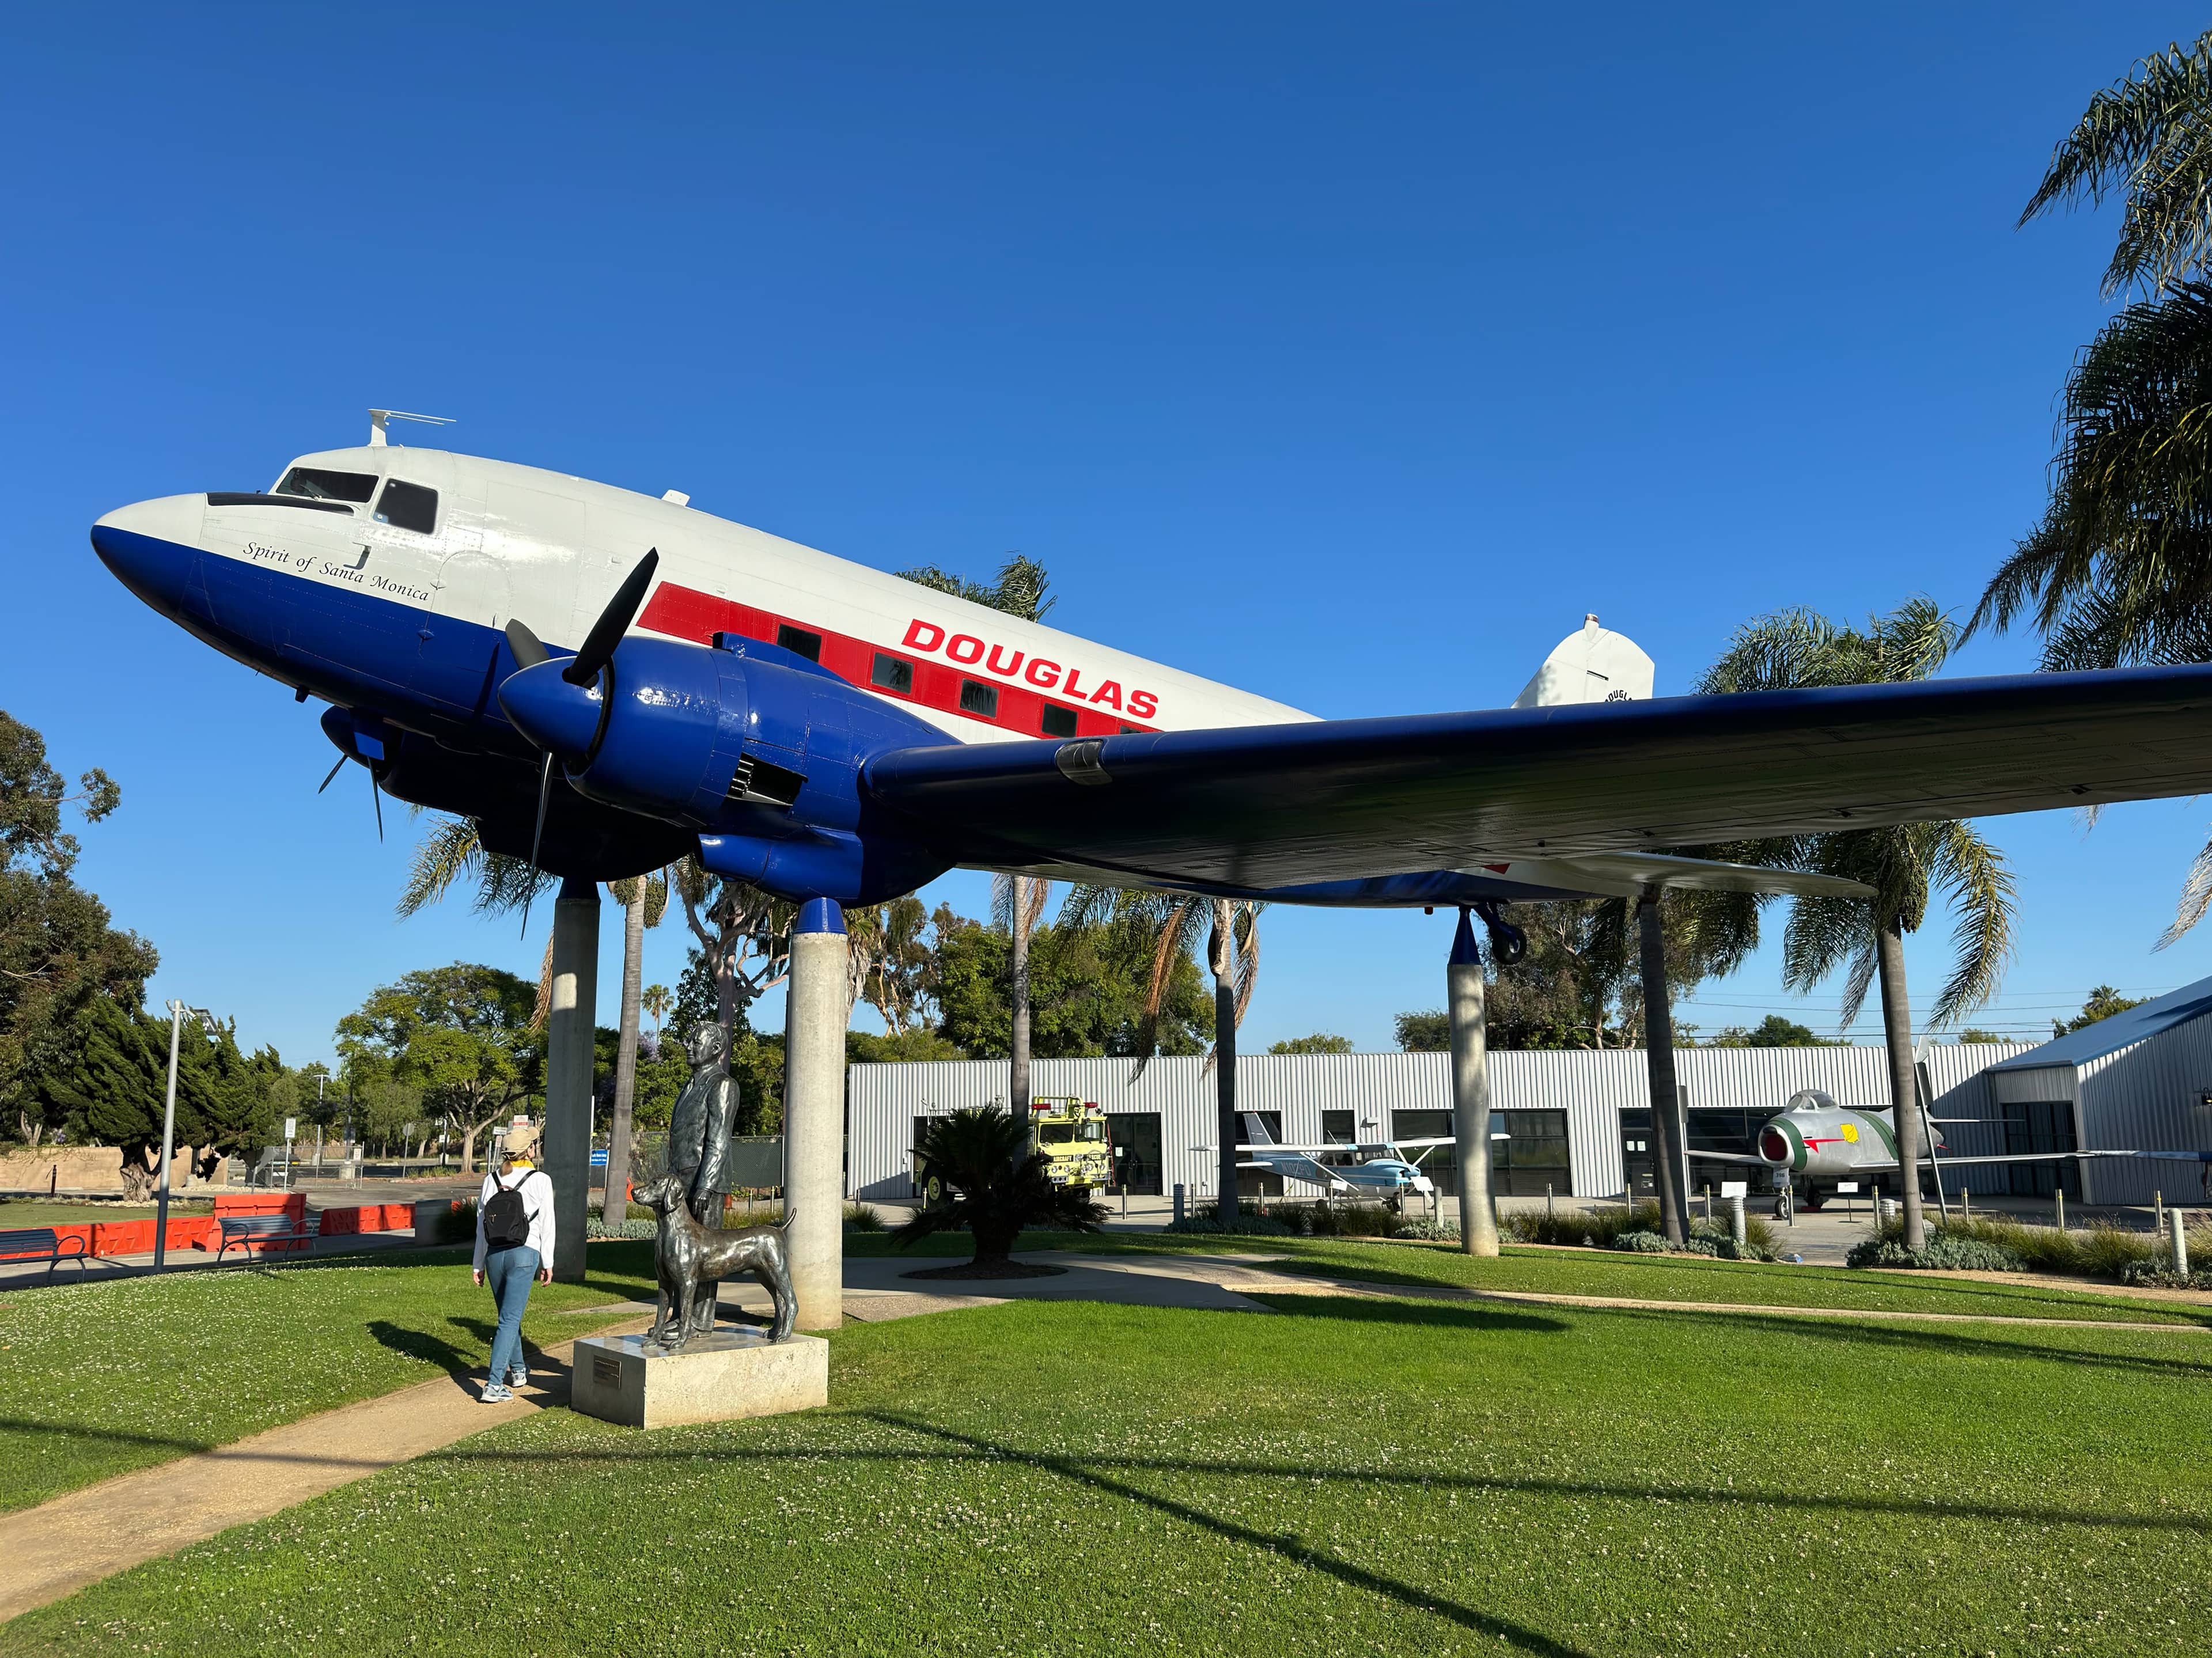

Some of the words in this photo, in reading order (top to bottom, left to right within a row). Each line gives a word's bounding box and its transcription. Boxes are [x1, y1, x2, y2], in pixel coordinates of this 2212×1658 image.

[243, 541, 290, 563] Spirit
[296, 556, 317, 572] of
[319, 562, 364, 583] Santa
[370, 575, 429, 601] Monica
[901, 619, 1158, 719] DOUGLAS
[1605, 689, 1632, 702] OUGL
